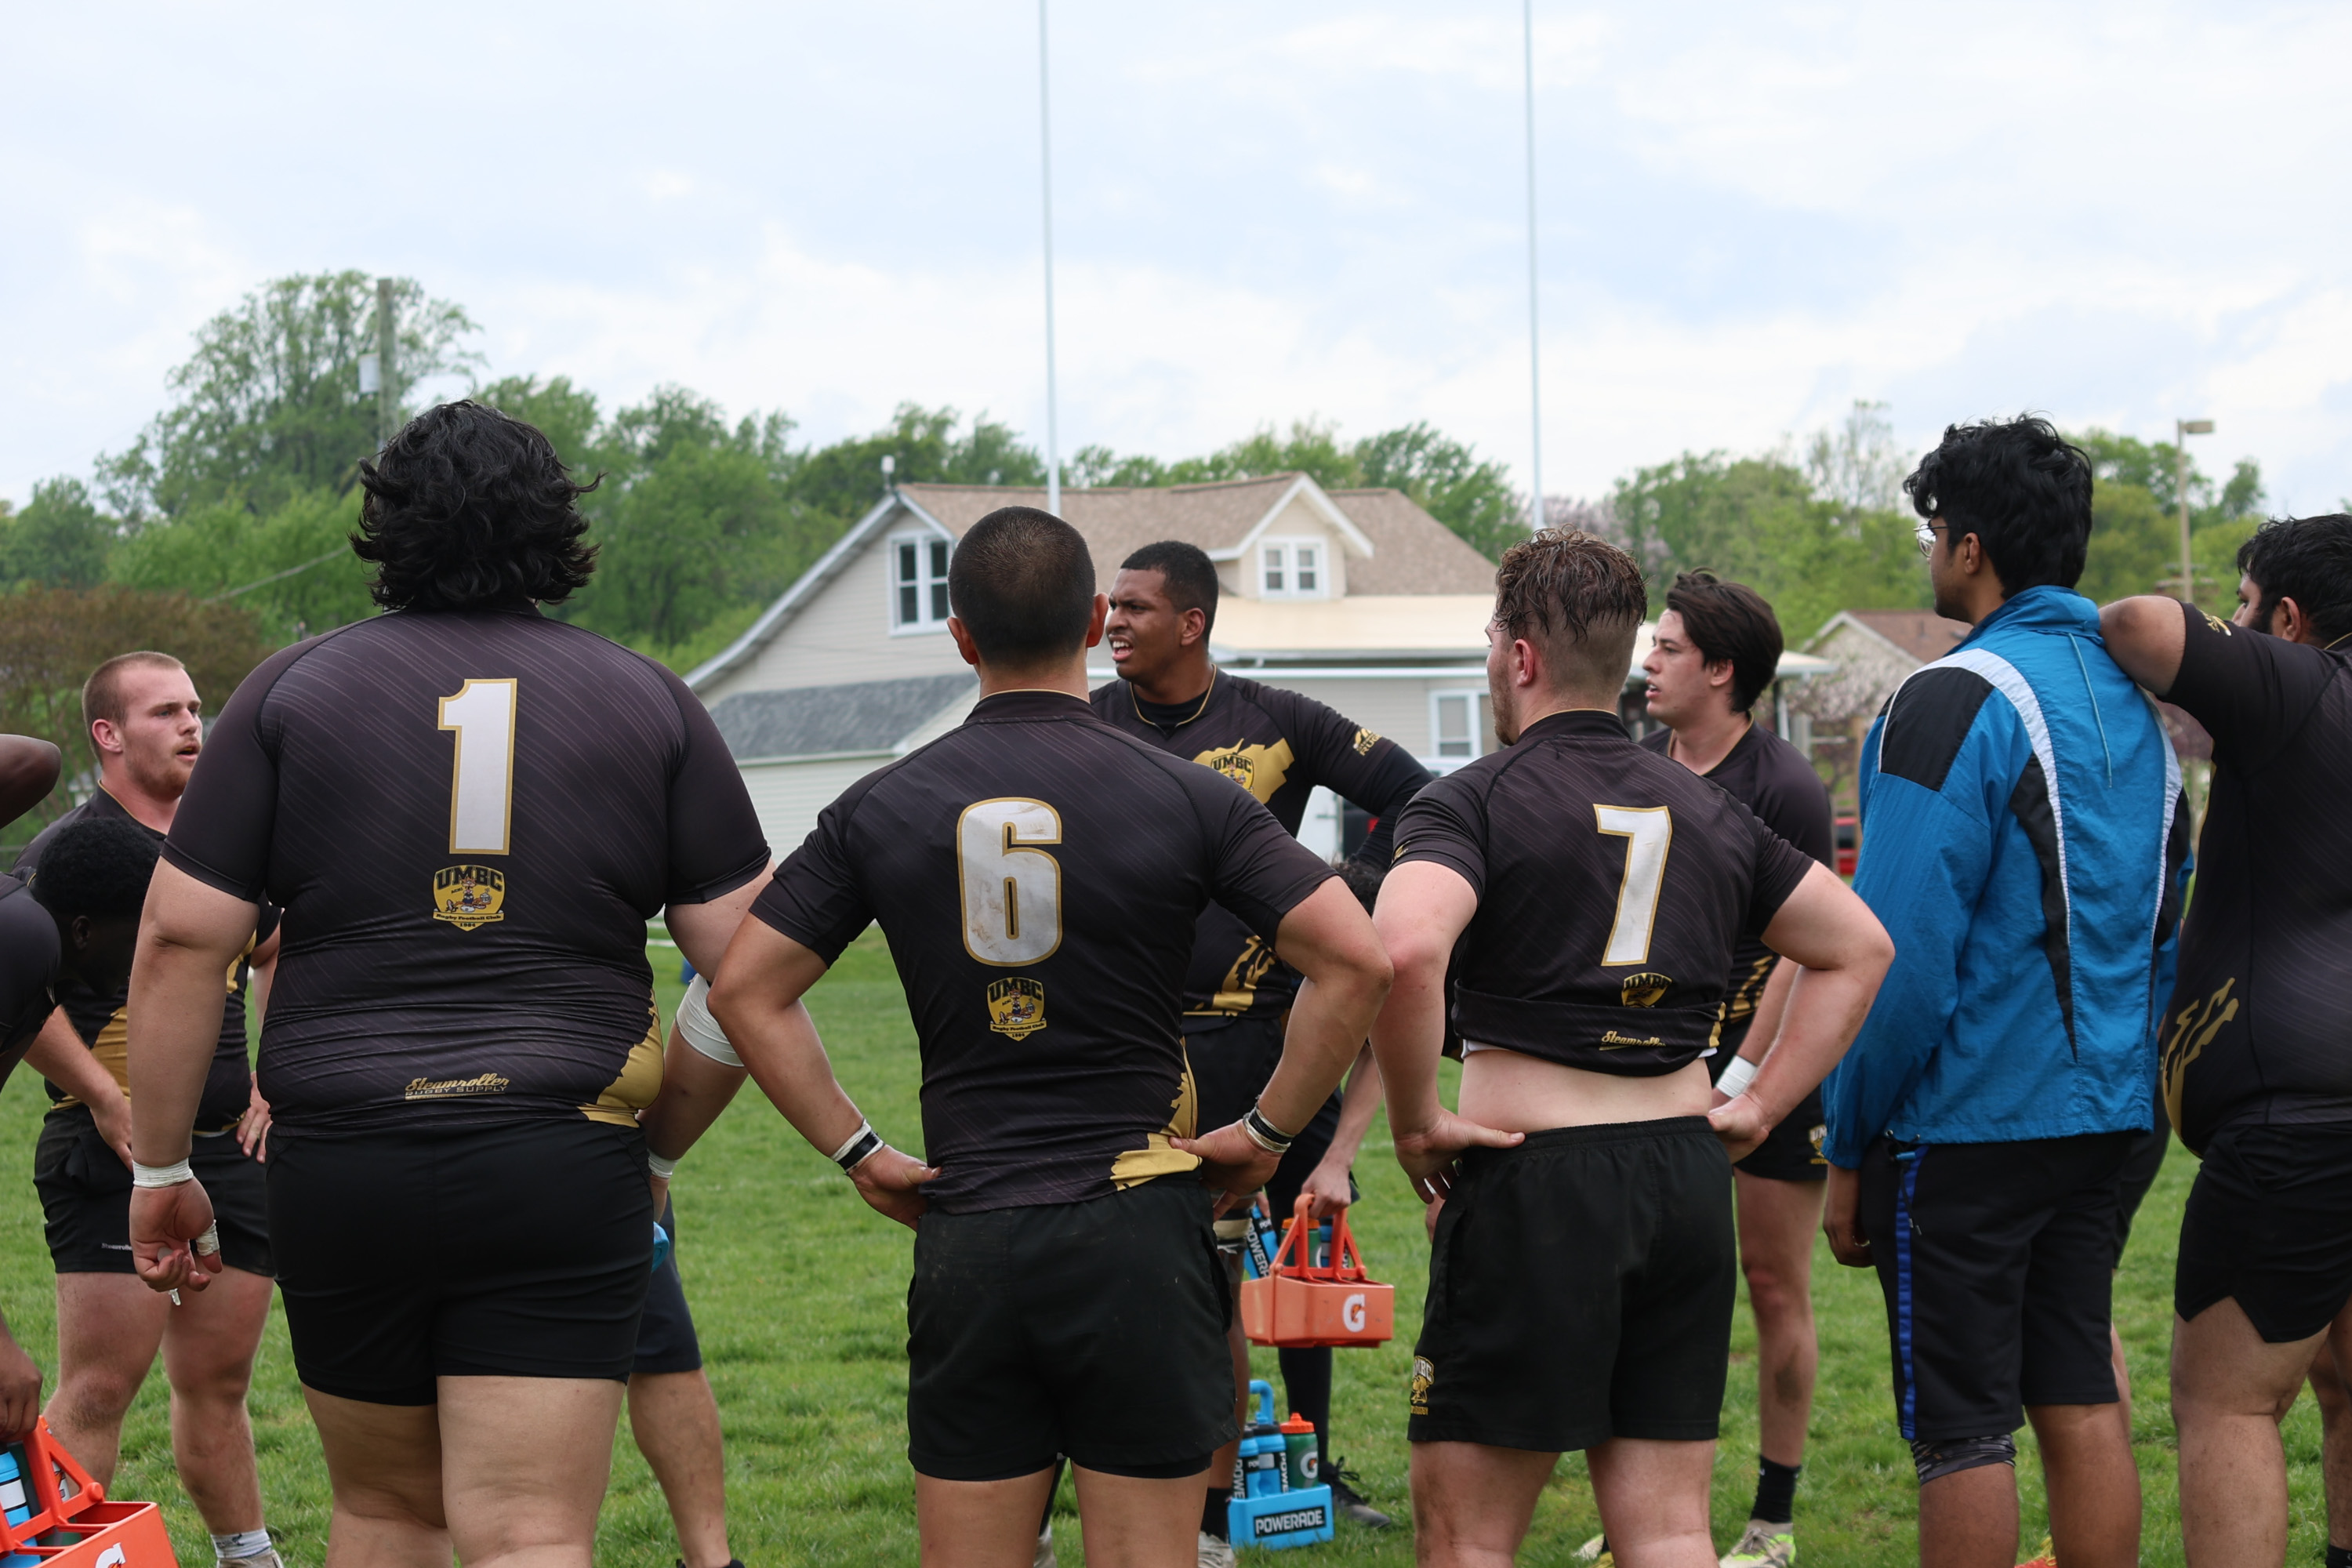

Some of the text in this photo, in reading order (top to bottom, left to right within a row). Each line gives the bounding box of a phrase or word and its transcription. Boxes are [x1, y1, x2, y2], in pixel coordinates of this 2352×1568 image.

[438, 678, 517, 855] 1
[1213, 755, 1252, 774] UMBC
[436, 865, 503, 891] UMBC
[956, 797, 1063, 967] 6
[1593, 804, 1672, 966] 7
[989, 978, 1044, 1003] UMBC
[405, 1073, 510, 1091] Steamroller
[405, 1087, 451, 1096] RUGBY
[1343, 1294, 1365, 1332] G
[1414, 1359, 1433, 1383] MBC
[1300, 1451, 1318, 1479] G
[1256, 1509, 1324, 1534] POWERADE
